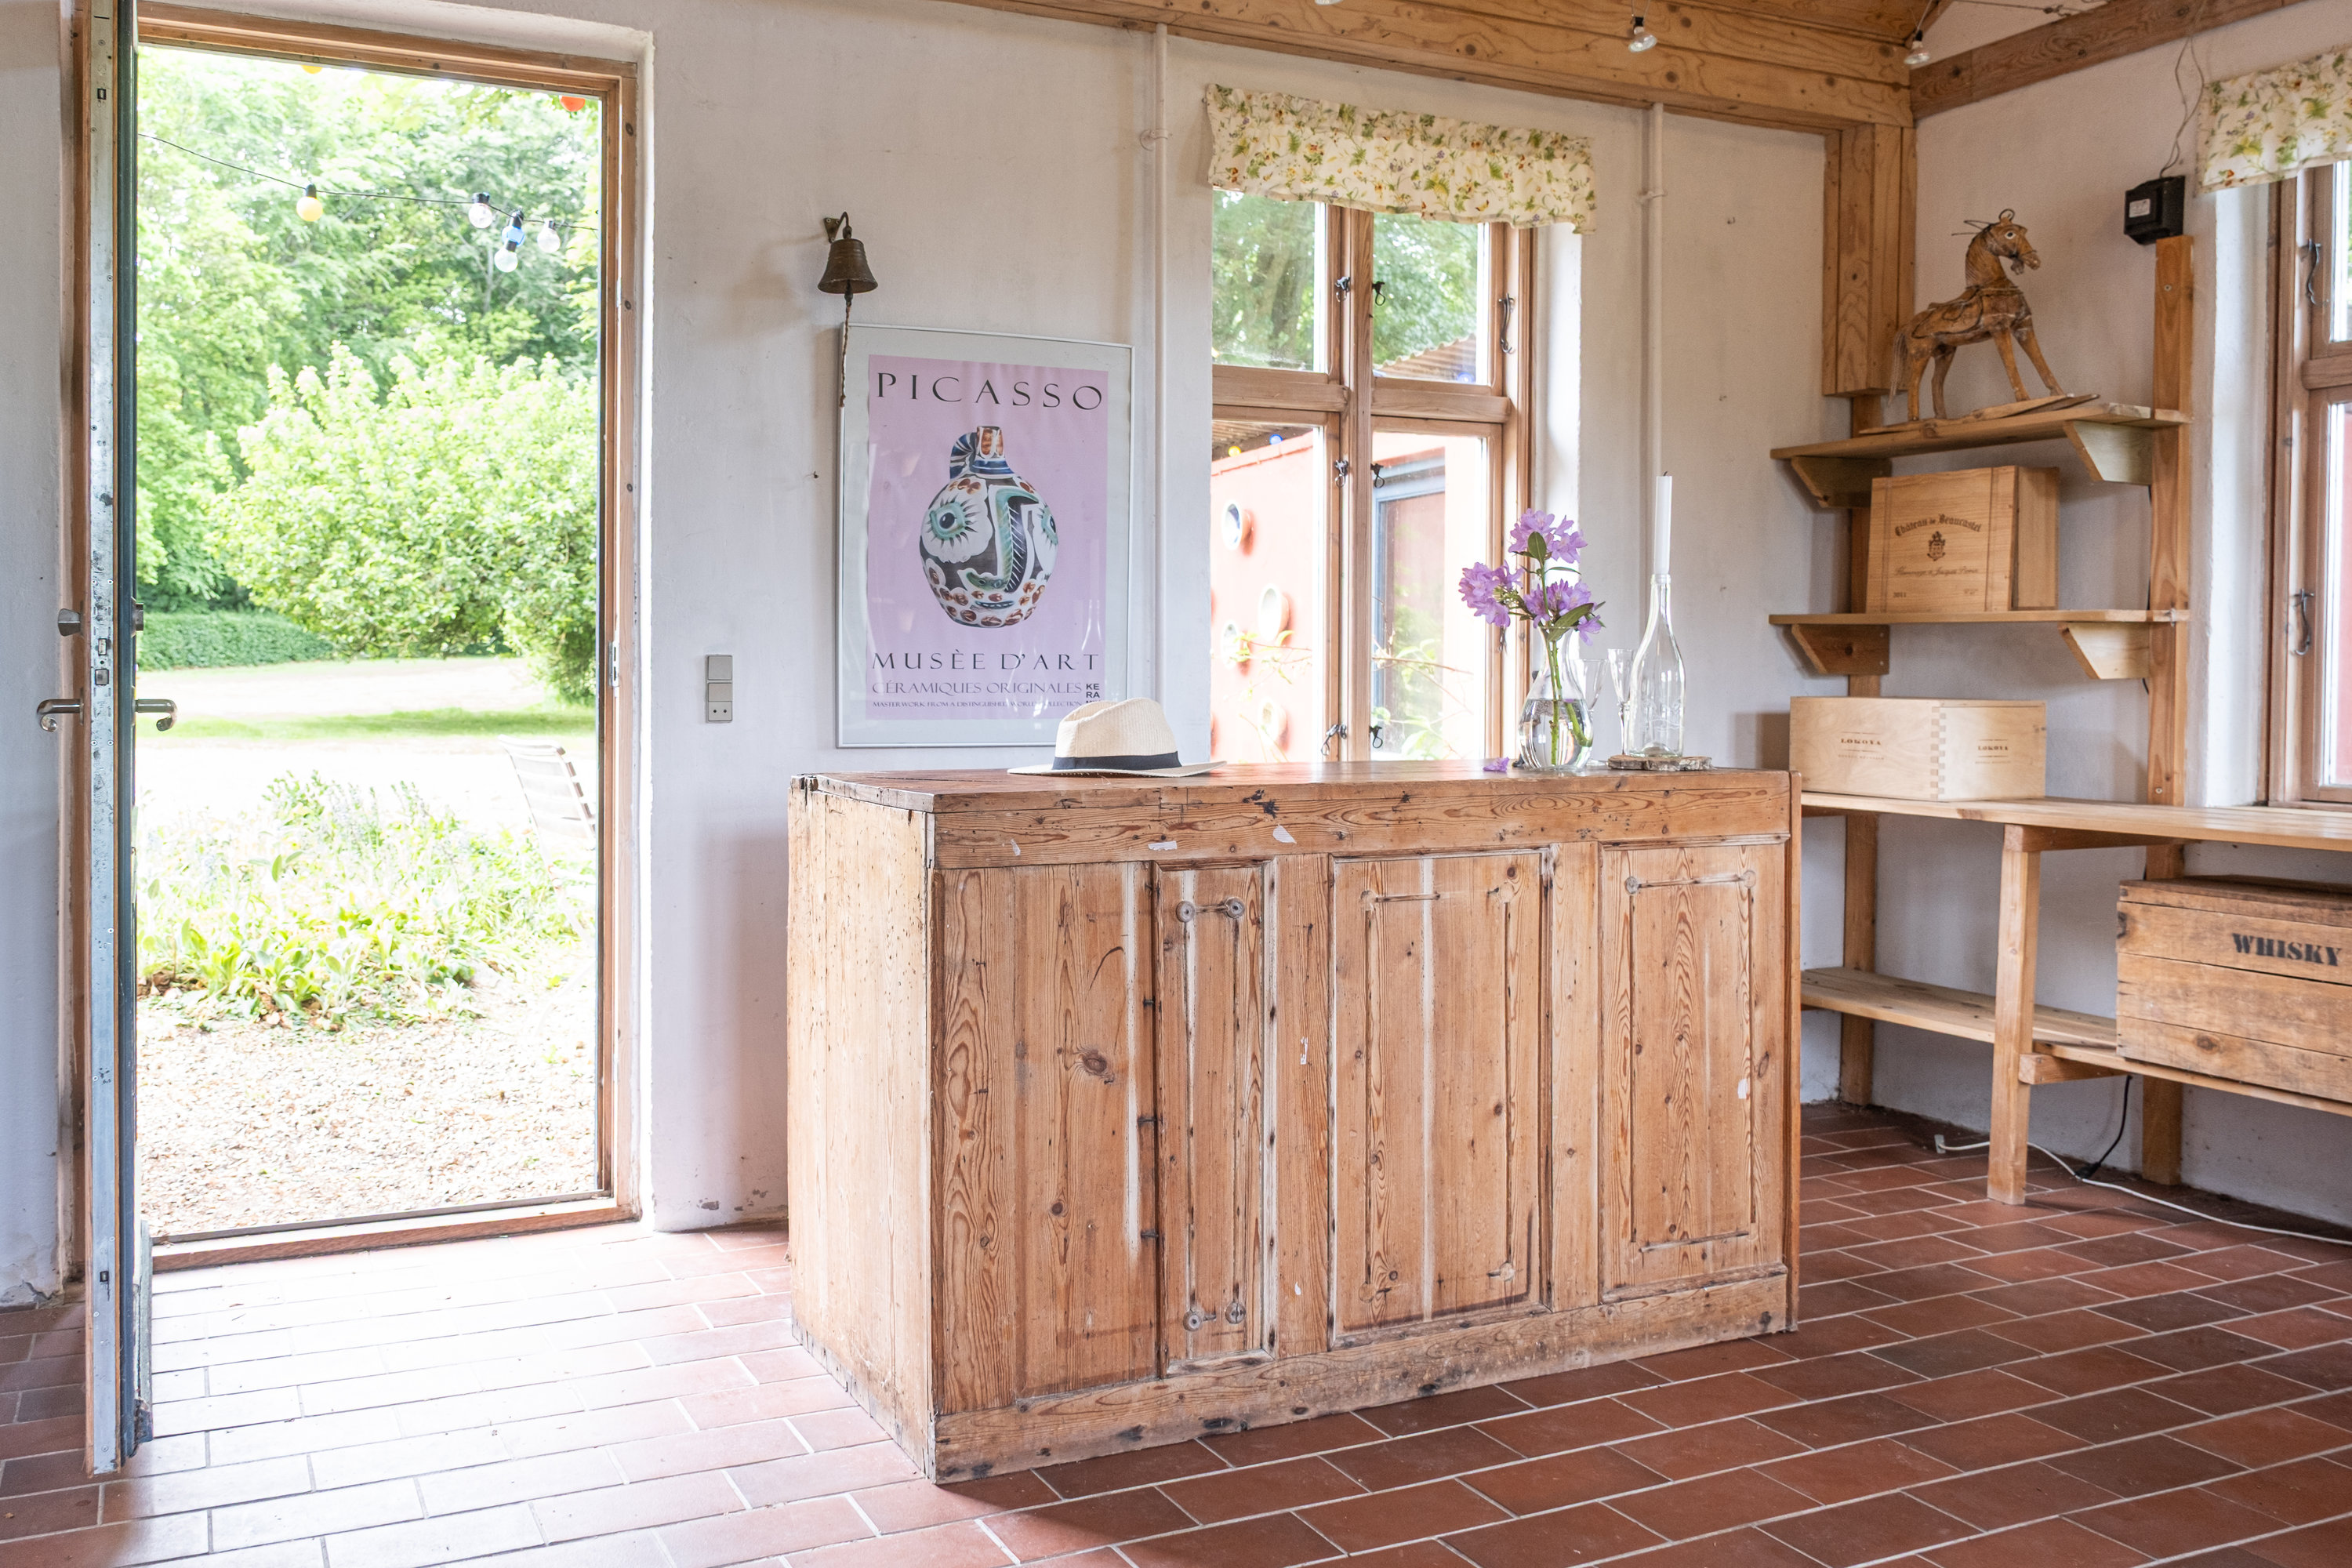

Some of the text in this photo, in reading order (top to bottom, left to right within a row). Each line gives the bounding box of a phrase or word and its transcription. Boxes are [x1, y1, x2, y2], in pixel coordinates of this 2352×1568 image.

[877, 372, 1102, 410] PICASSO
[872, 648, 1099, 670] MUSÈE D'ART
[872, 680, 1083, 697] CÉRAMIQUES ORIGINALES
[2232, 933, 2343, 967] WHISKY
